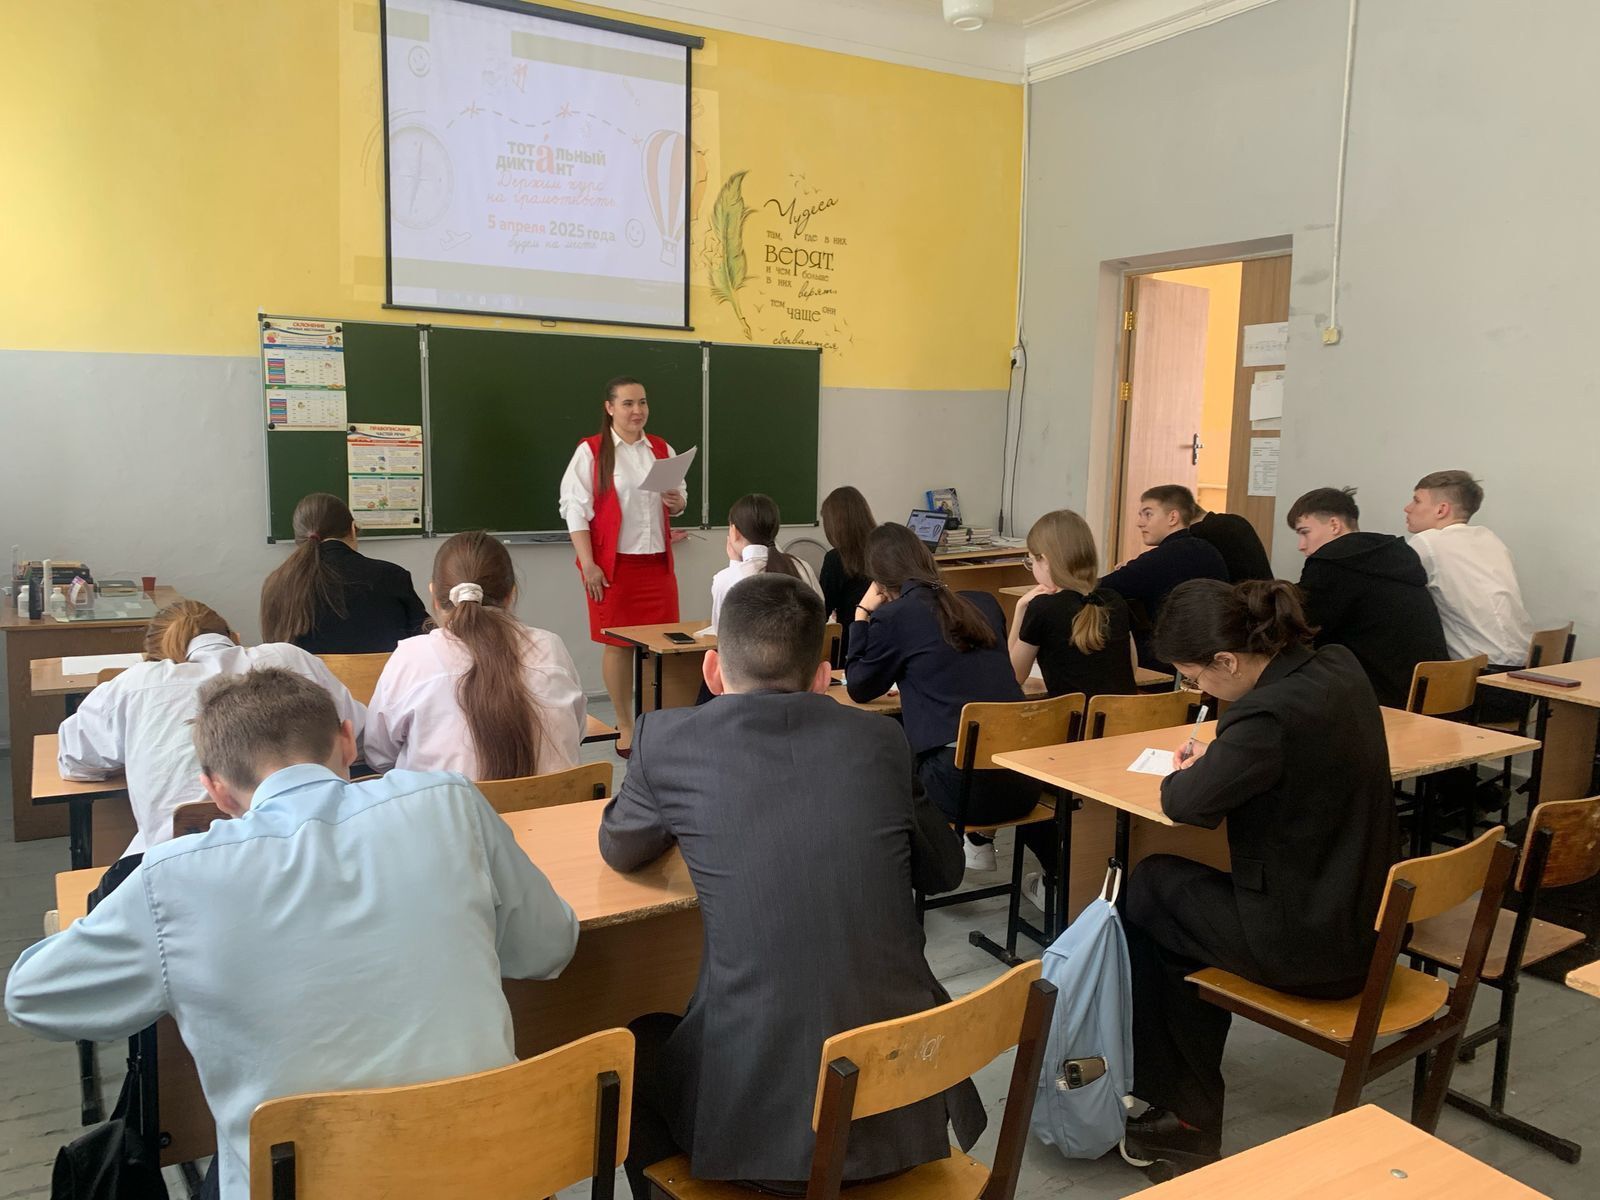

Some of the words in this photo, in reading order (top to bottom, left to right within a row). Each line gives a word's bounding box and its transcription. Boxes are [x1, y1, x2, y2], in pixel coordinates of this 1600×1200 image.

[487, 193, 505, 203] на
[763, 197, 839, 239] Чудеса
[487, 214, 496, 229] 5
[499, 220, 546, 236] апреля
[549, 220, 585, 238] 2025
[587, 228, 616, 242] года
[801, 270, 830, 282] больше
[777, 279, 792, 288] них
[786, 307, 821, 322] чаще
